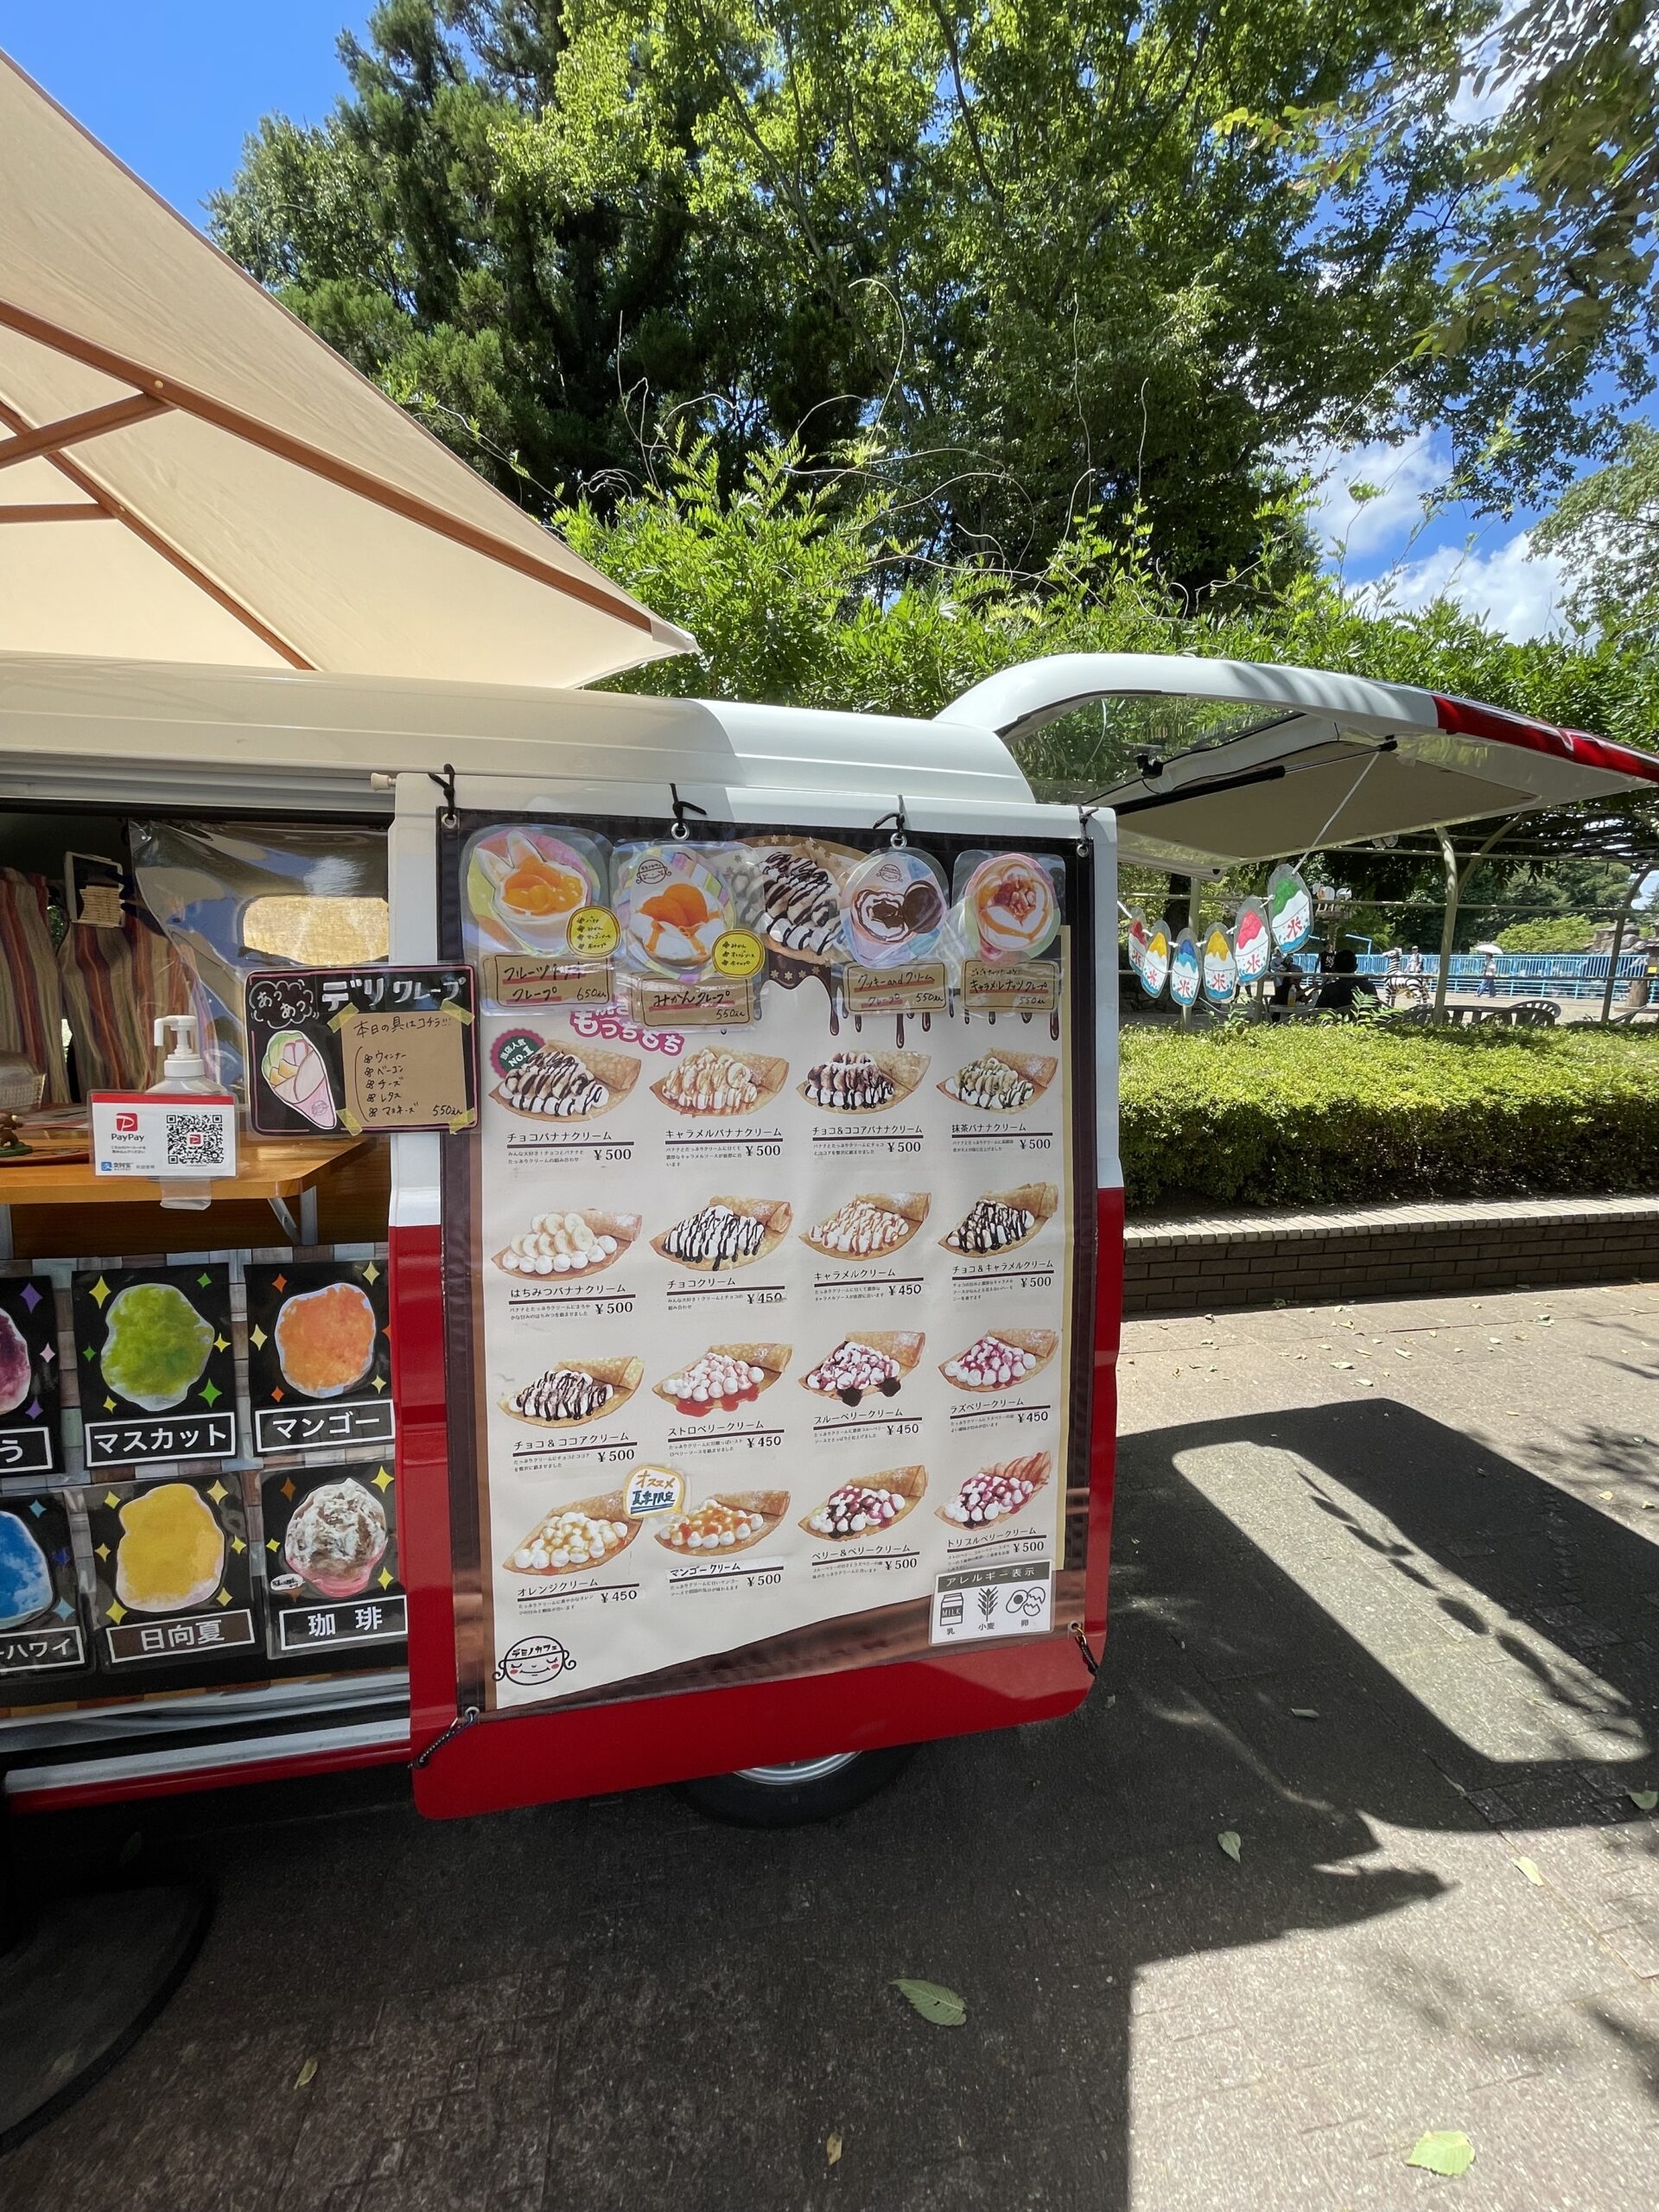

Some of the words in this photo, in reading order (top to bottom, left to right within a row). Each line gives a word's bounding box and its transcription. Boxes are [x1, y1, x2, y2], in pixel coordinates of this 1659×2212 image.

[512, 987, 557, 1002] クレープ
[508, 1046, 534, 1067] NO.1
[378, 1065, 404, 1074] ベーコン
[378, 1077, 405, 1090] チーズ
[380, 1093, 402, 1103] レタス
[665, 1128, 782, 1138] キャラメルバナナクリーム
[952, 1123, 1027, 1133] 抹茶バナナクリーム
[507, 1132, 612, 1142] チョコバナナクリーム
[815, 1268, 896, 1281] キャラメルクリーム
[667, 1277, 736, 1289] チョコクリーム
[511, 1284, 626, 1298] はちみつバナナクリーム
[950, 1398, 1024, 1414] ラズベリークリーム
[814, 1408, 903, 1424] ブルーベリークリーム
[272, 1411, 380, 1440] マンゴー
[668, 1421, 764, 1436] ストロベリークリーム
[94, 1424, 227, 1454] マスカット
[947, 1527, 1037, 1548] トリプルベリークリーム
[946, 1567, 1035, 1586] アレルギー表示
[518, 1579, 598, 1597] オレンジクリーム
[942, 1607, 961, 1617] MILK
[308, 1607, 383, 1637] 珈琲
[141, 1619, 225, 1651] 日向夏
[0, 1638, 70, 1659] ハワイ
